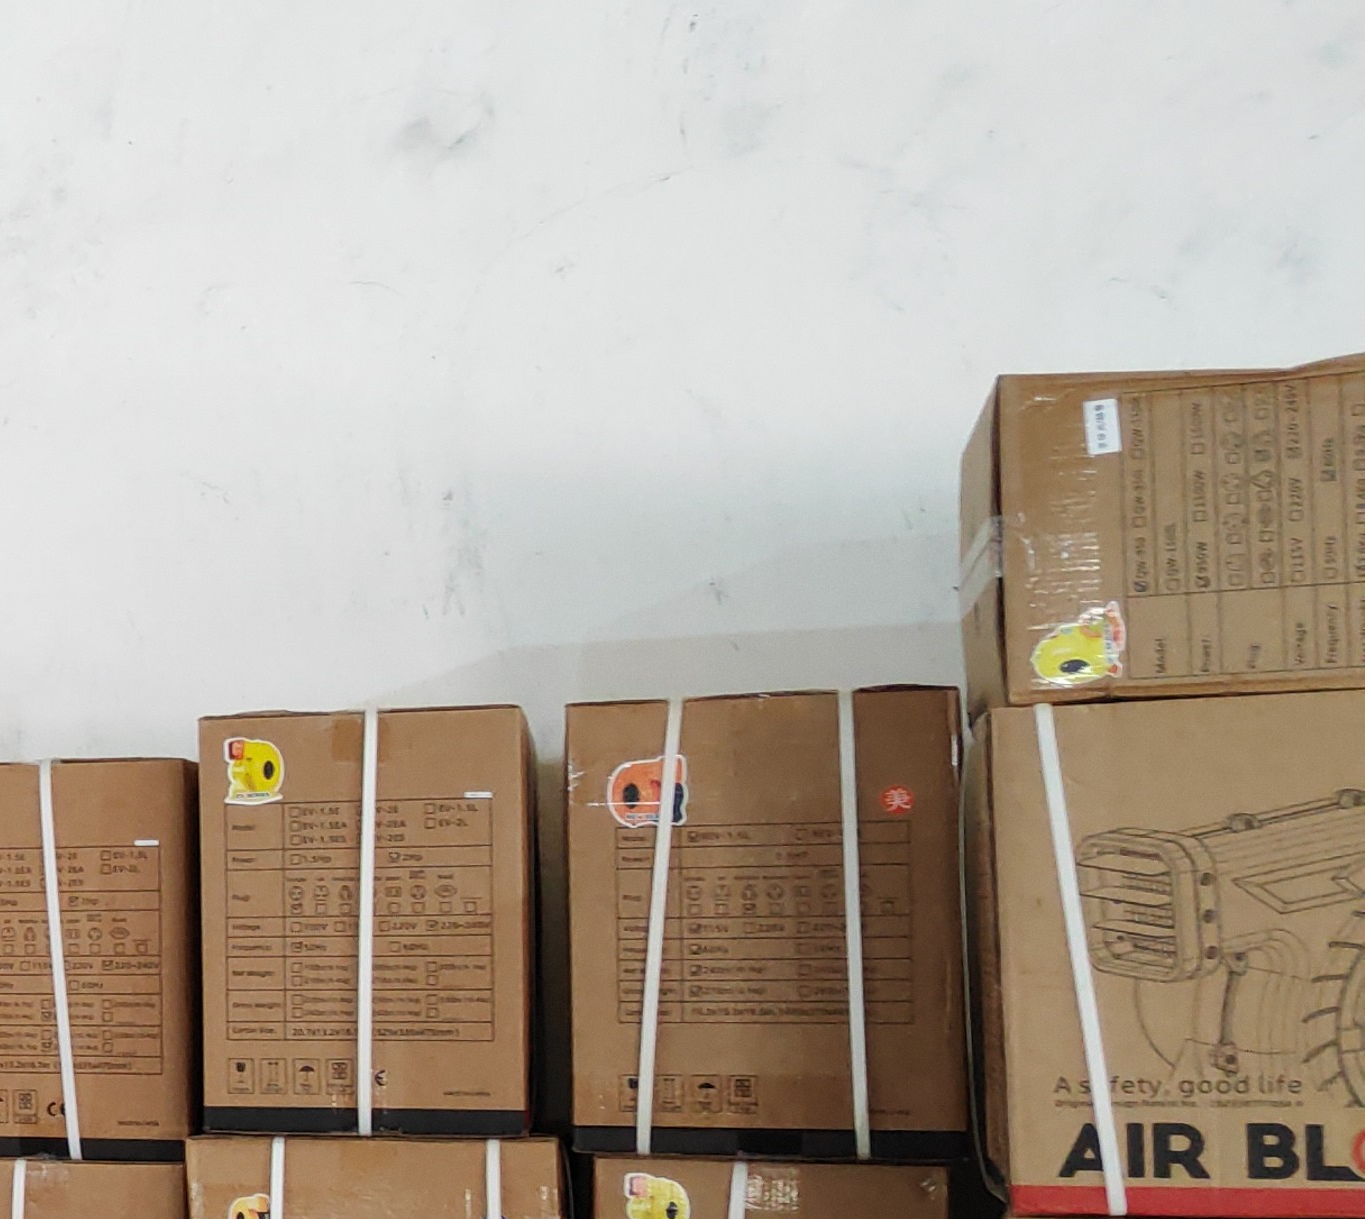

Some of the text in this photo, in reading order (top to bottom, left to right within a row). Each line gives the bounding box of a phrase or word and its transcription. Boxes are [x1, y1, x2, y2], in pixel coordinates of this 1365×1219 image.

[887, 790, 910, 811] 美
[1178, 1076, 1249, 1097] good
[1257, 1075, 1303, 1094] life
[1058, 1121, 1365, 1181] AIR BL
